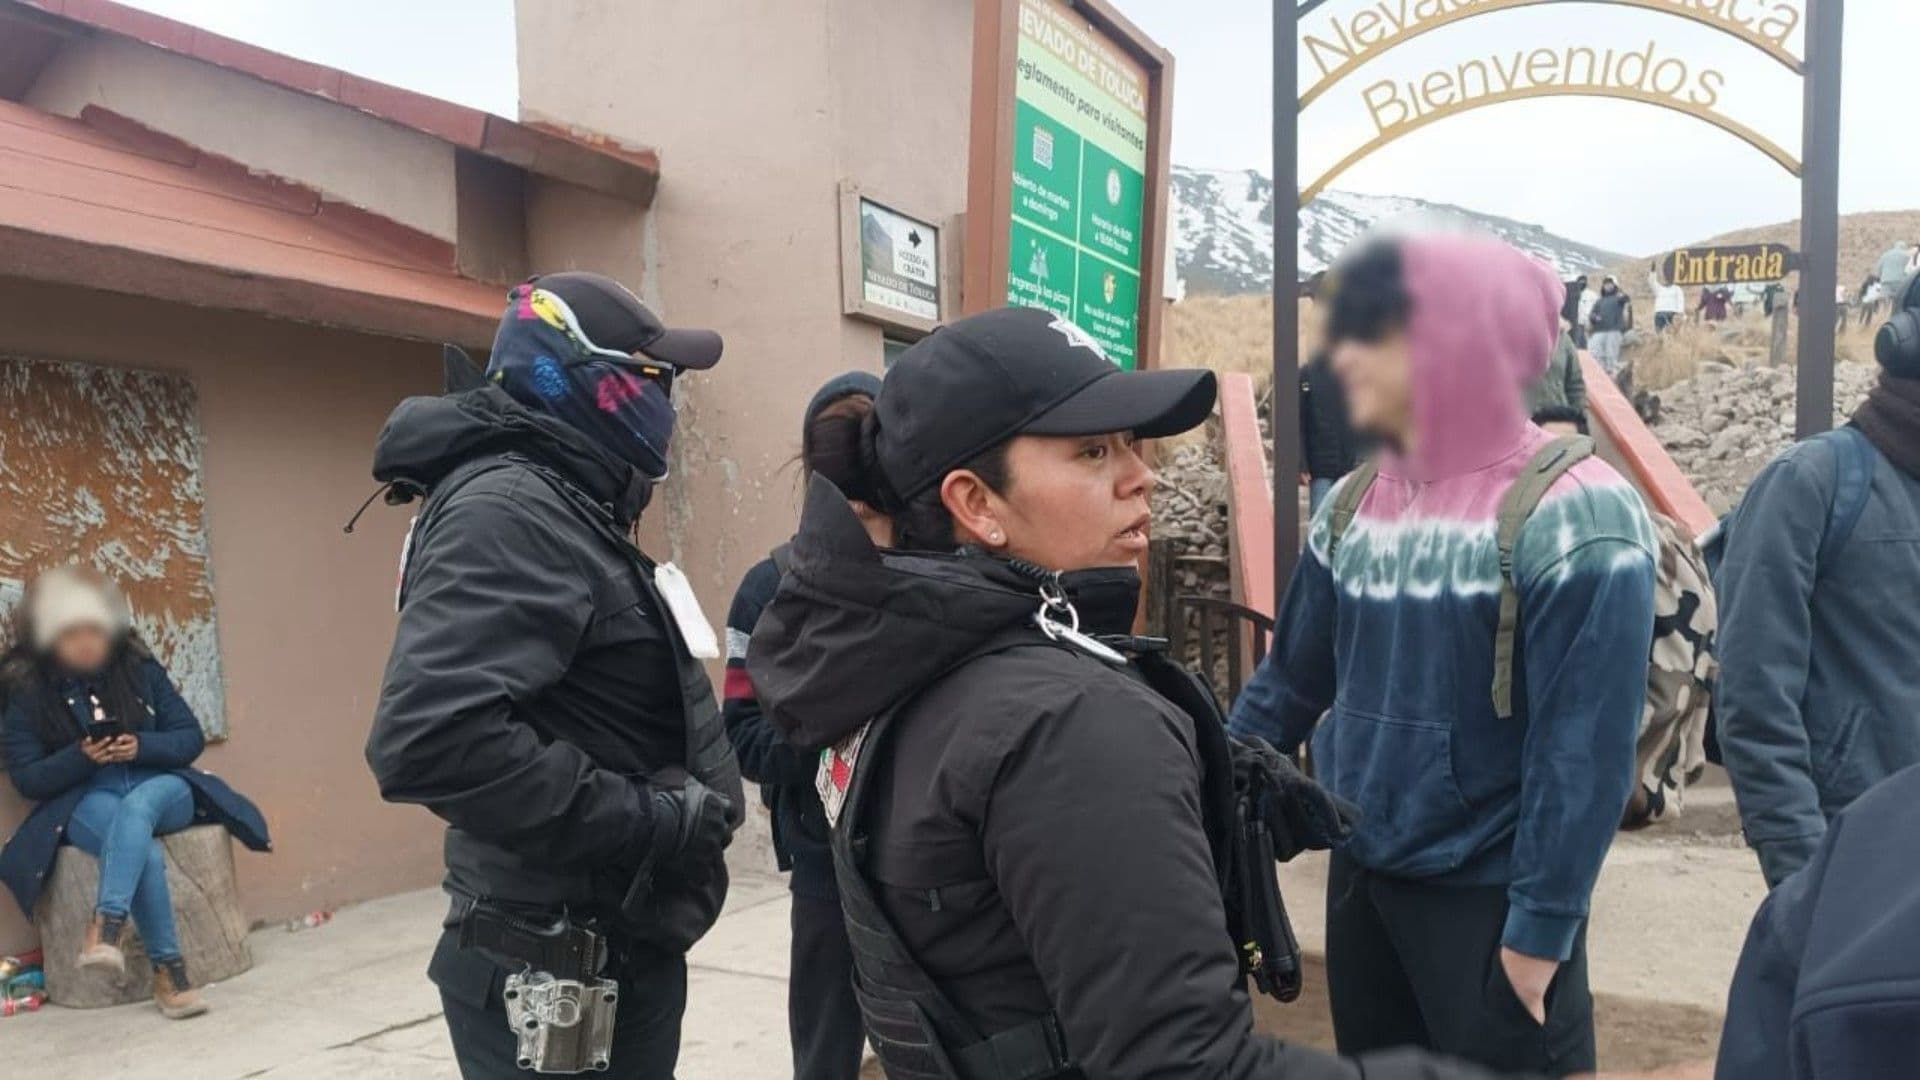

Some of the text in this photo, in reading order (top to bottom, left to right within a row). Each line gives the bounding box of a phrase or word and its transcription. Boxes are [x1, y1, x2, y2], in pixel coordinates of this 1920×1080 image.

[1017, 57, 1075, 105] eglamento
[1077, 98, 1101, 120] para
[1102, 112, 1144, 151] visitantes
[1078, 47, 1096, 81] DE
[1098, 62, 1147, 117] TOLUCA
[1361, 40, 1725, 136] Bienvenidos
[1673, 244, 1784, 285] Entrada
